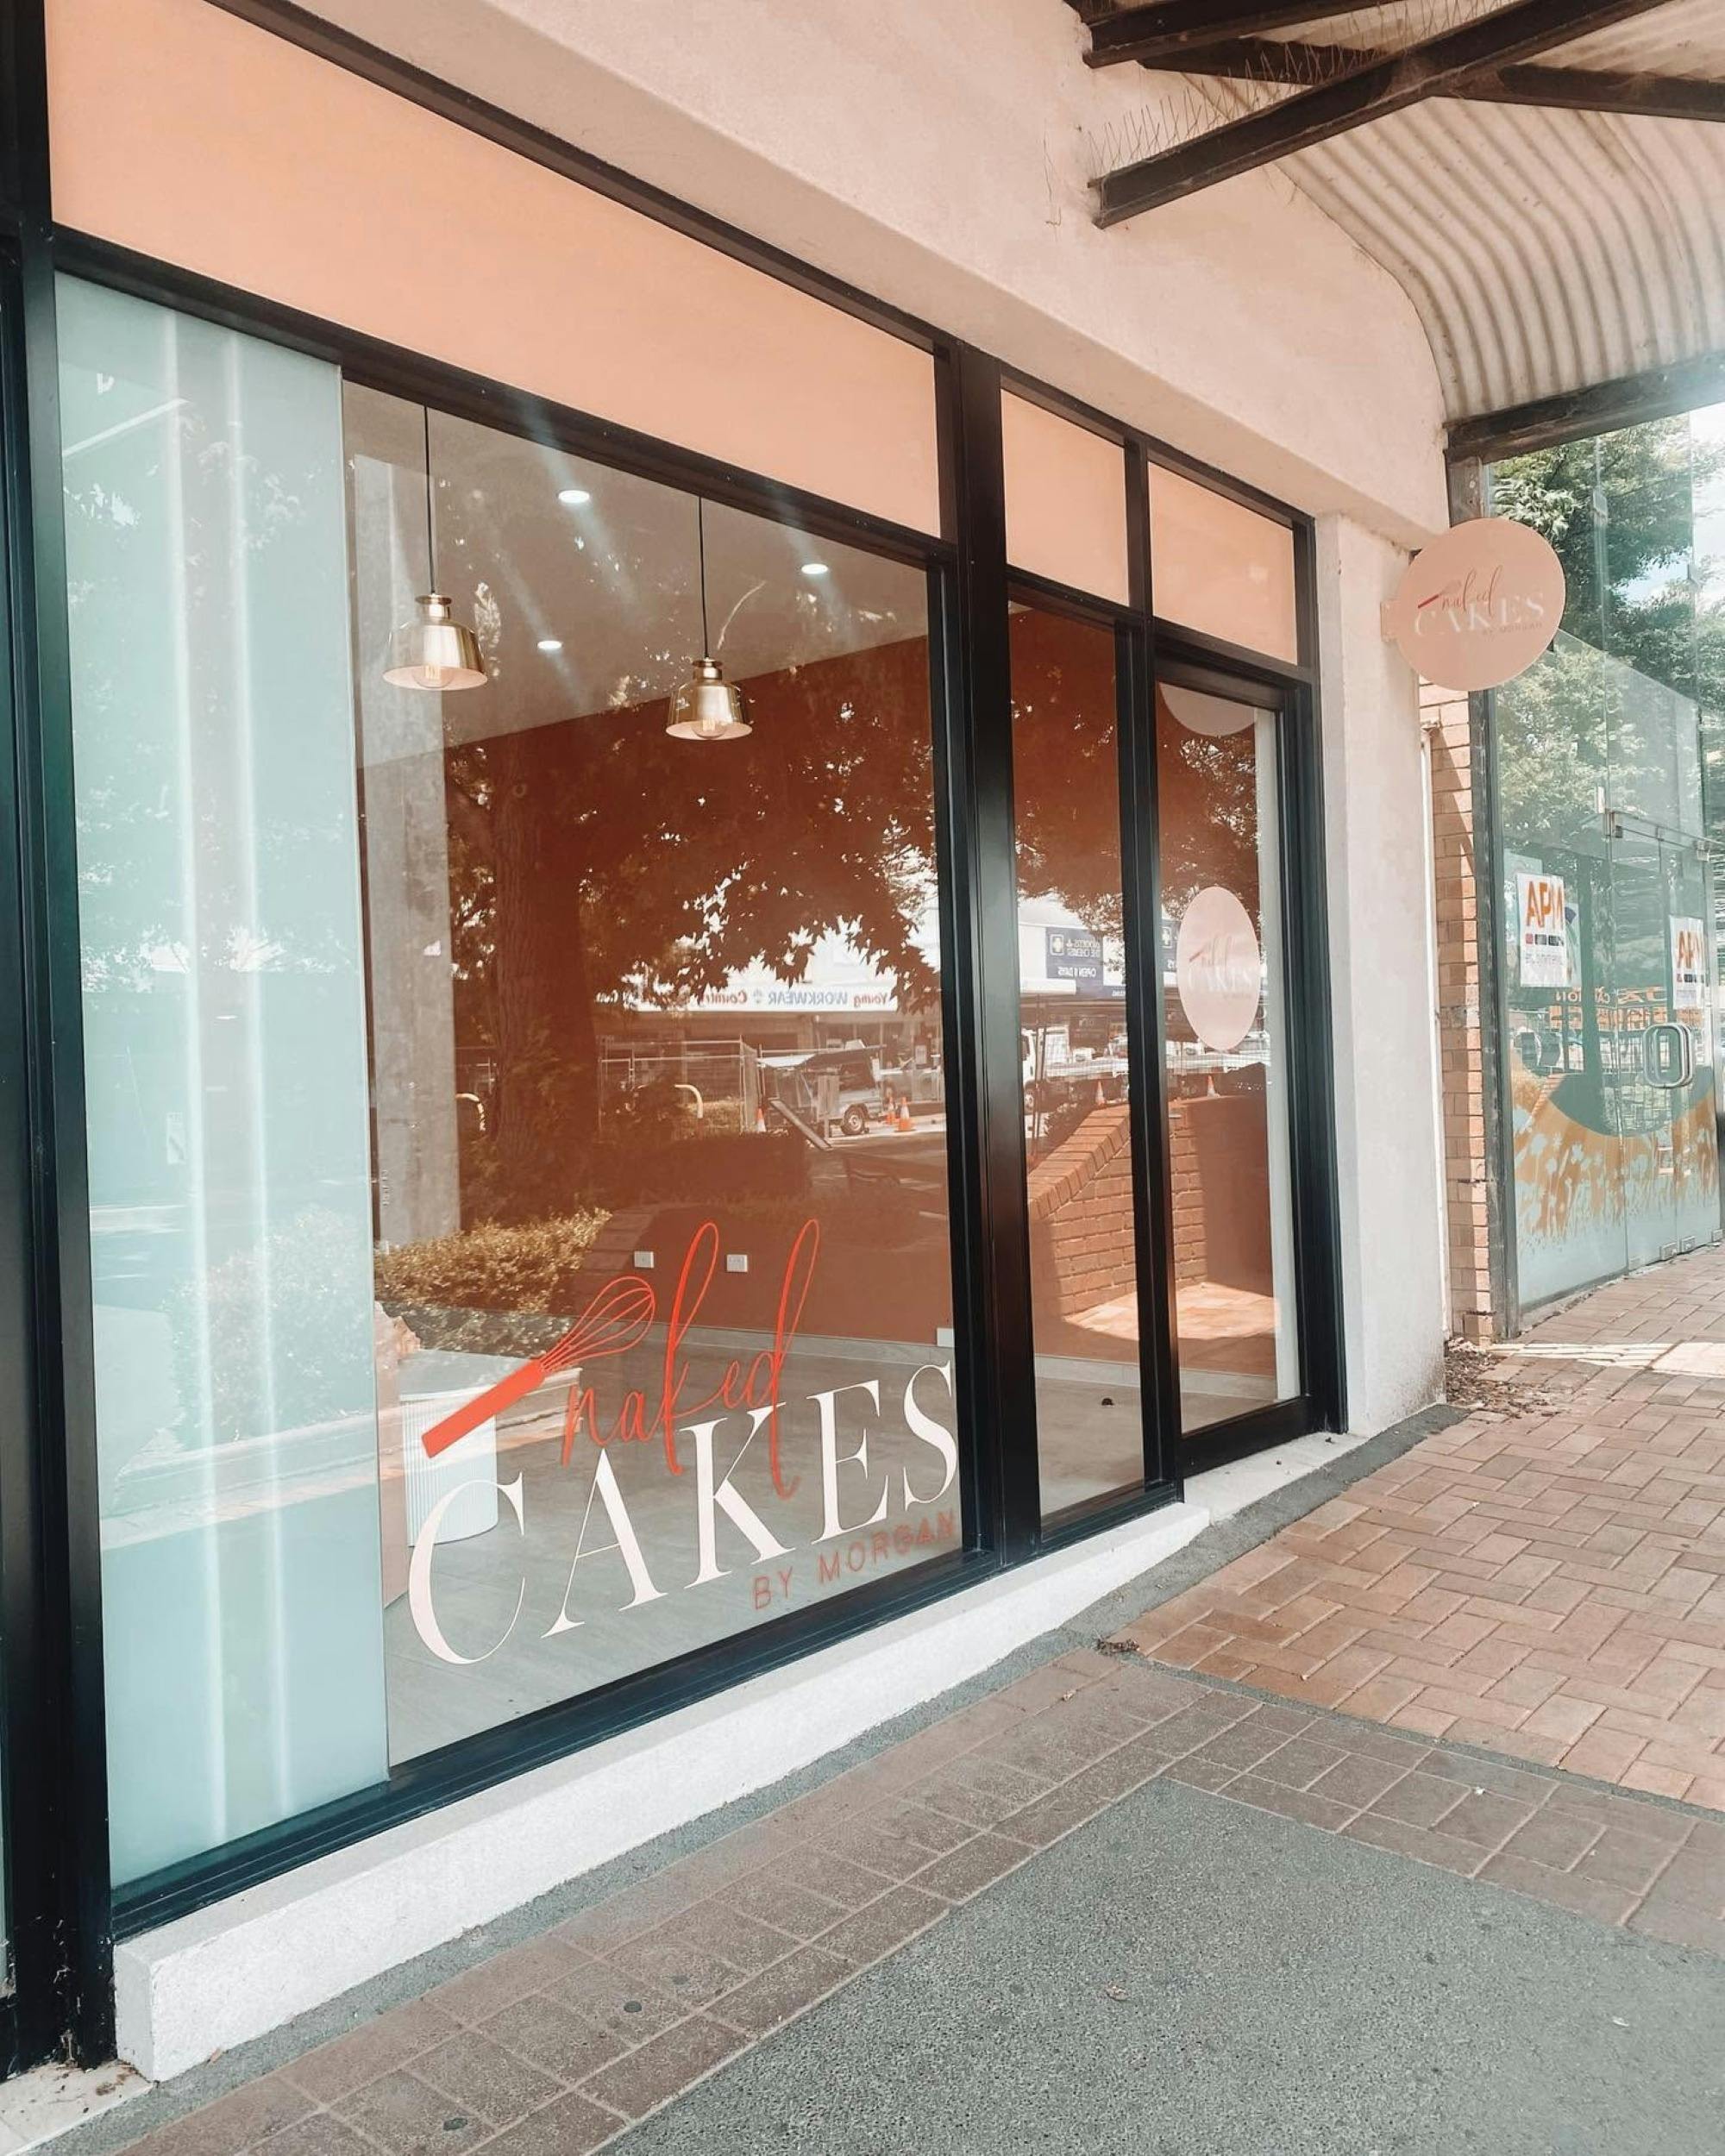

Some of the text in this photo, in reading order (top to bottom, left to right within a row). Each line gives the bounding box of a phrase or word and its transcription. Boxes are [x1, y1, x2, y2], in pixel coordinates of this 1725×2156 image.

[1414, 592, 1544, 636] CAKES
[561, 1218, 820, 1501] naked
[408, 1360, 958, 1665] CAKES
[752, 1507, 957, 1611] BY MORGAN
